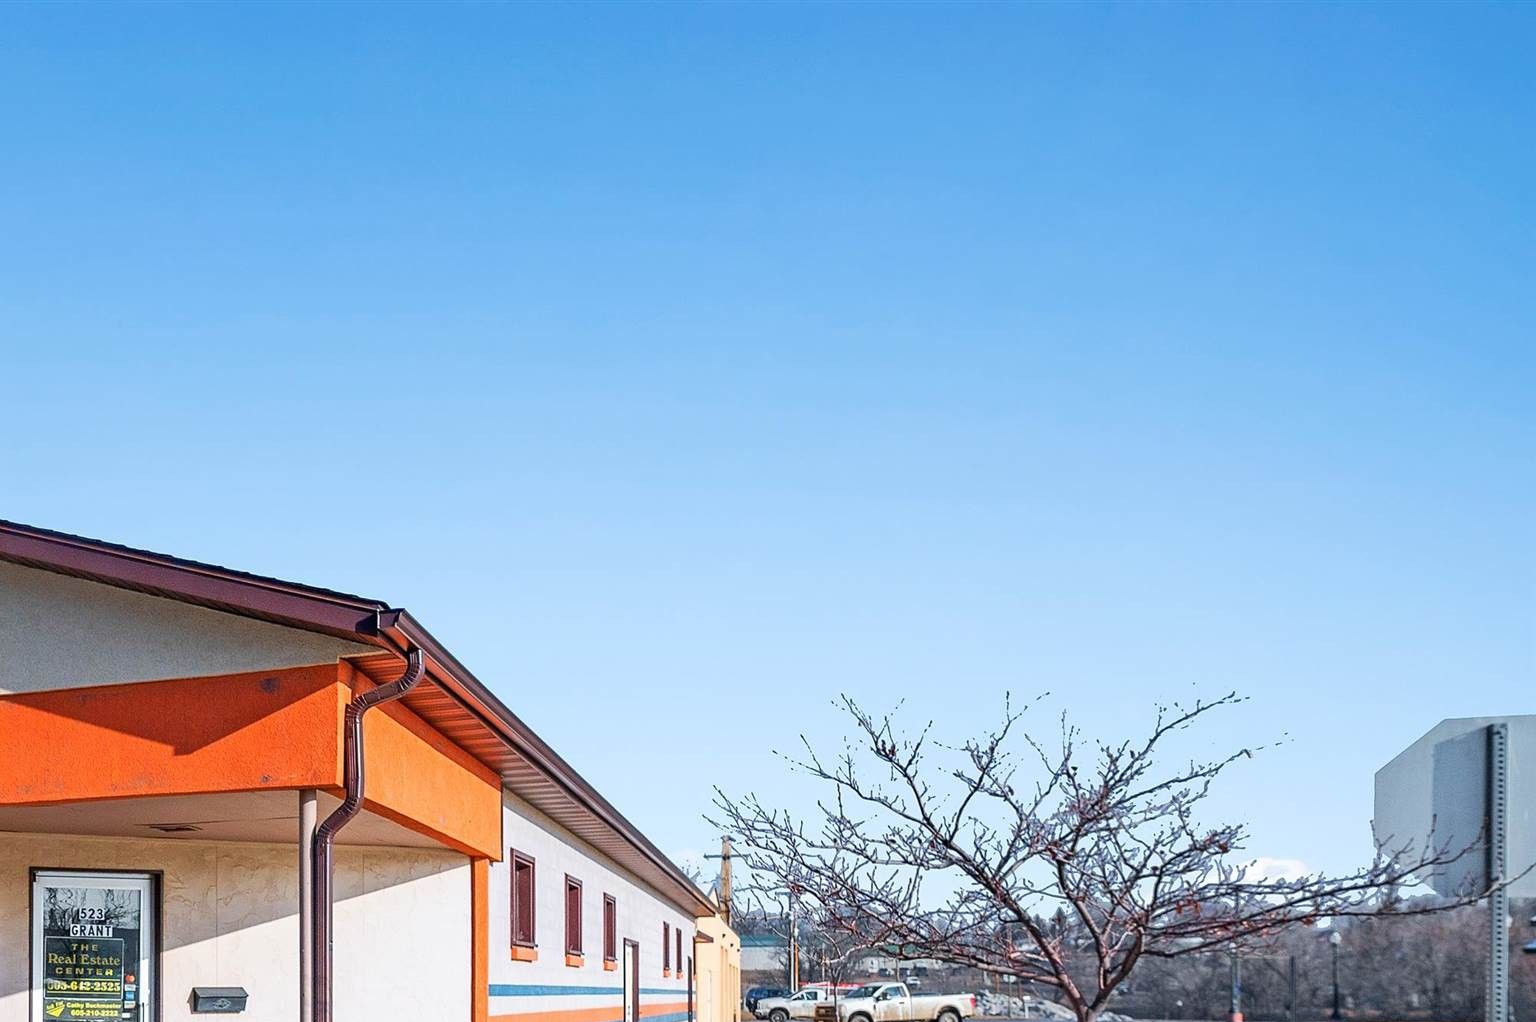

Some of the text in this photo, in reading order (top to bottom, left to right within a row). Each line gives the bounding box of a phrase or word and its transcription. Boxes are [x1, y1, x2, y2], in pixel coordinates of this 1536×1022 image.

[80, 907, 104, 919] 523
[71, 925, 112, 937] GRANT
[71, 943, 99, 952] THE
[48, 952, 121, 966] Real Estate
[55, 967, 114, 976] CENTER
